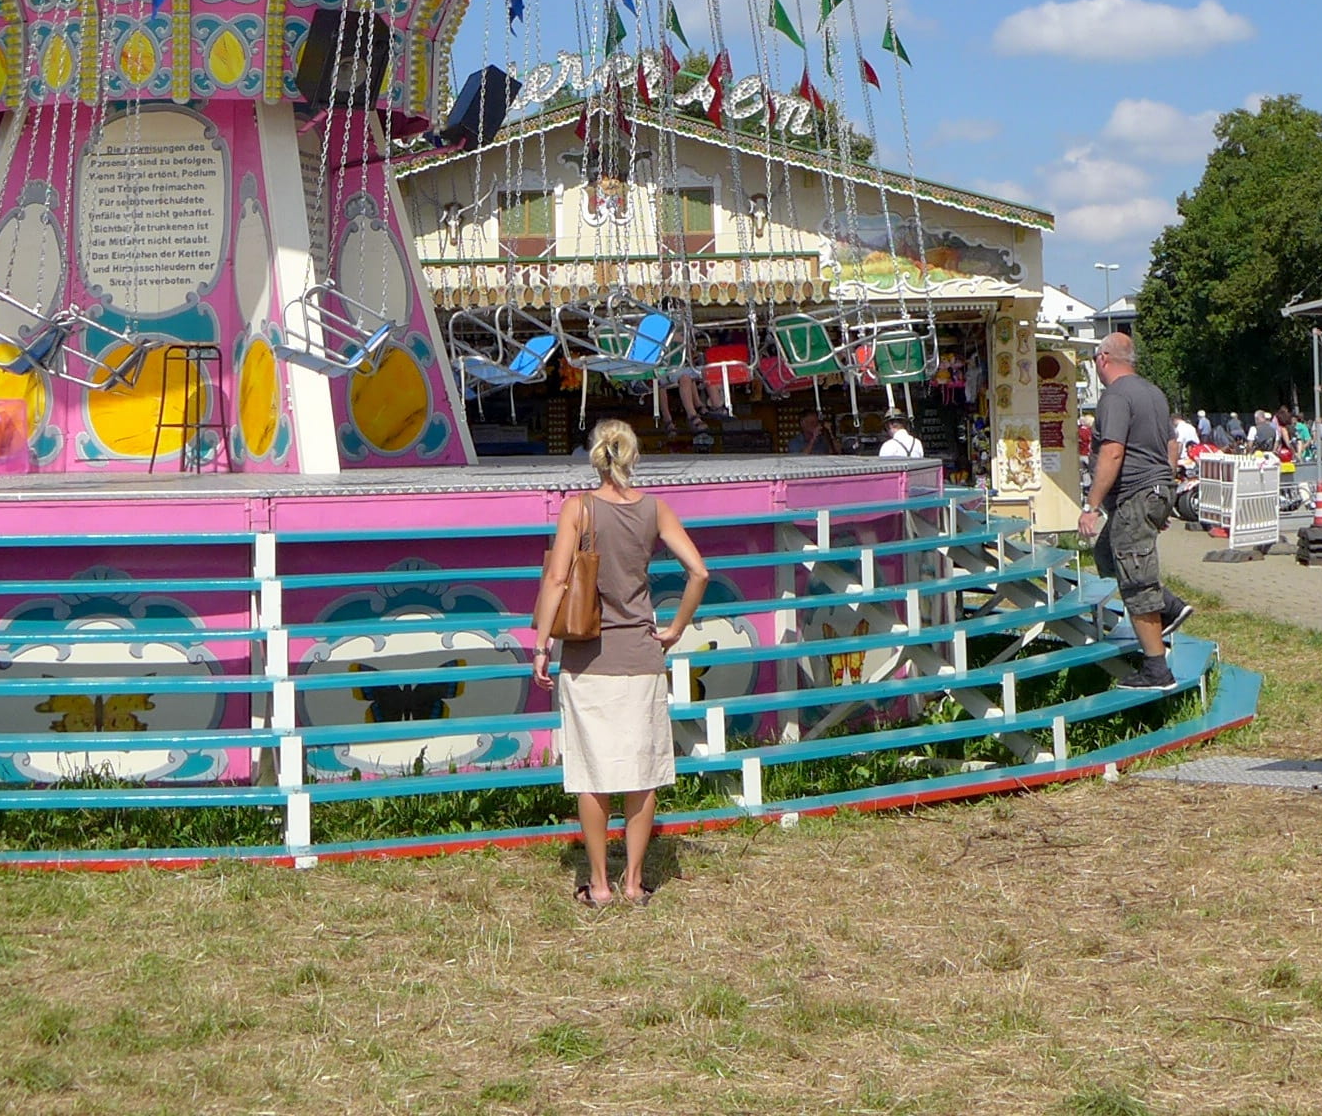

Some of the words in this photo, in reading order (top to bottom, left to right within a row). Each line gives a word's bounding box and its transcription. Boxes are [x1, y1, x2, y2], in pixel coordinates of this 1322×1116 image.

[107, 145, 121, 153] Die
[188, 143, 205, 151] des
[173, 156, 216, 166] befolgen.
[182, 169, 216, 177] Podium
[98, 185, 115, 193] und
[146, 210, 170, 218] nicht
[173, 209, 215, 219] gehaftet.
[197, 222, 209, 230] ist
[148, 237, 172, 245] nicht
[174, 235, 210, 244] erlaubt.
[92, 252, 109, 260] Das
[160, 249, 176, 258] der
[178, 249, 211, 257] Ketten
[93, 265, 109, 273] und
